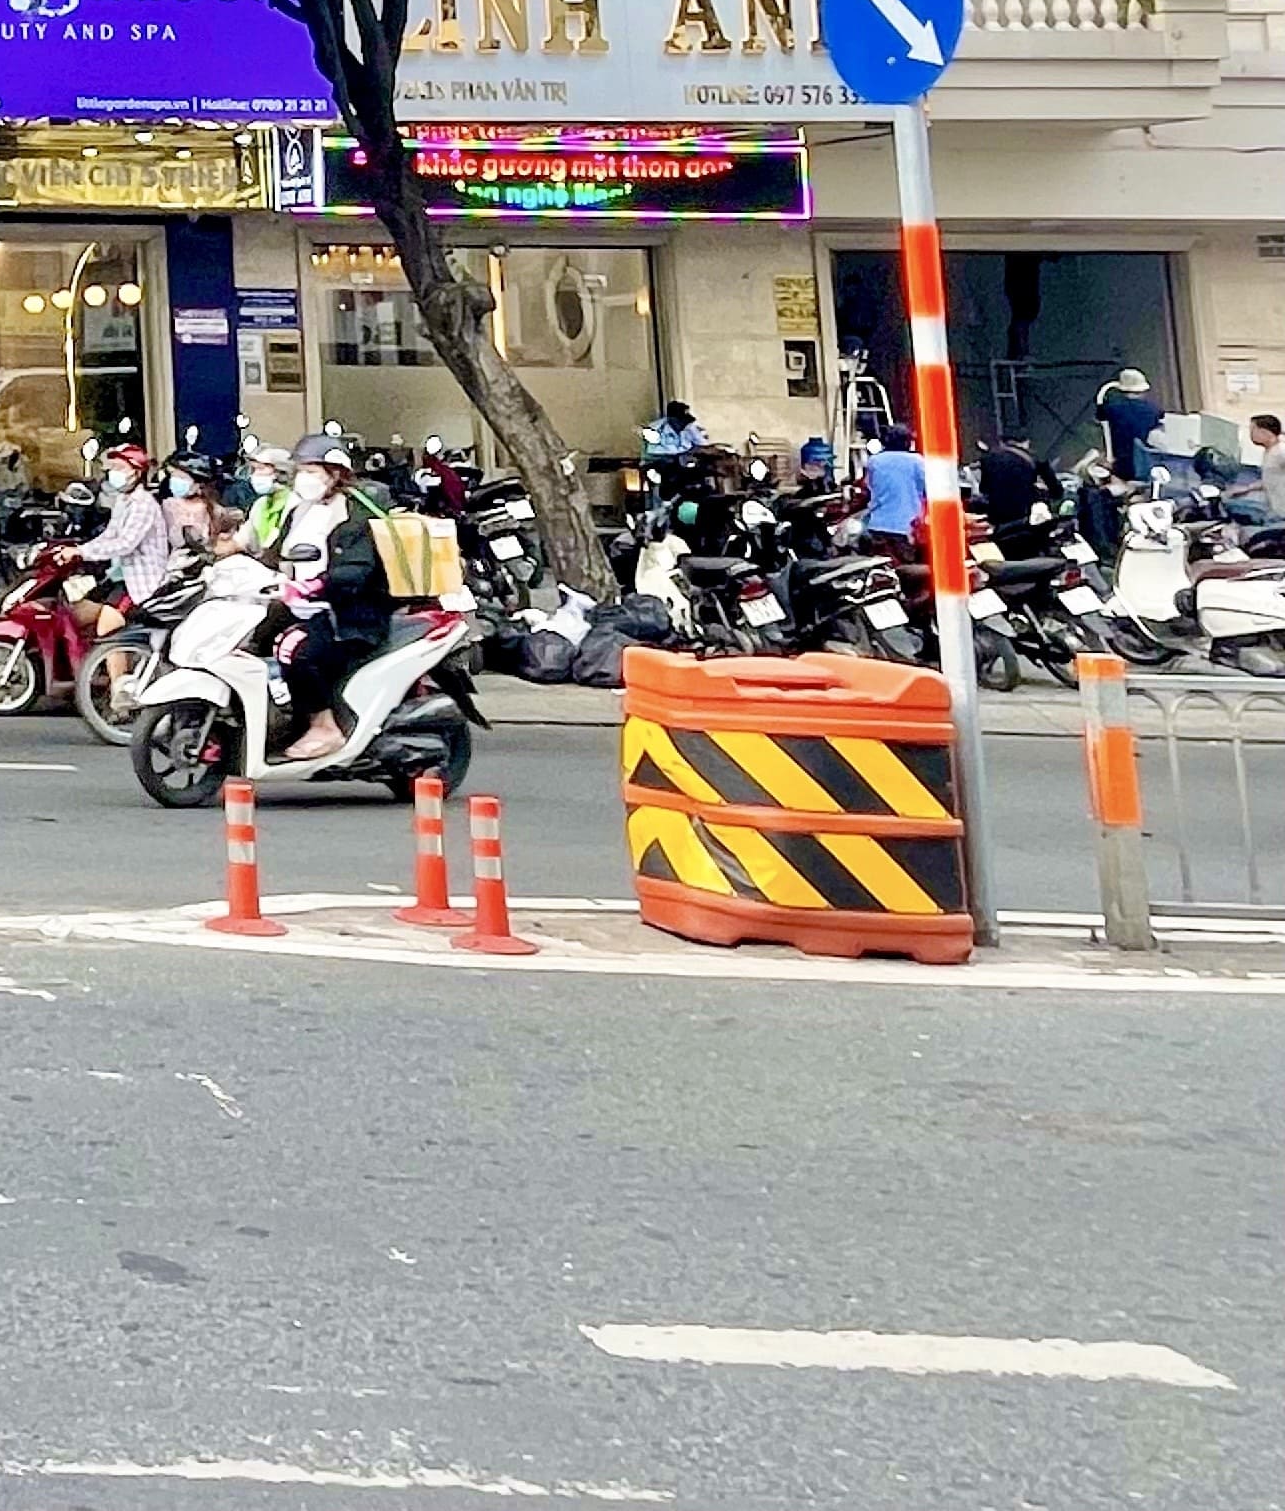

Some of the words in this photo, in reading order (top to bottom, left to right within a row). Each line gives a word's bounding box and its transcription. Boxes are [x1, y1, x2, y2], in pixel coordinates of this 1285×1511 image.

[63, 23, 115, 40] AND
[130, 23, 177, 42] SPA
[801, 85, 833, 105] 576
[621, 155, 680, 178] thon
